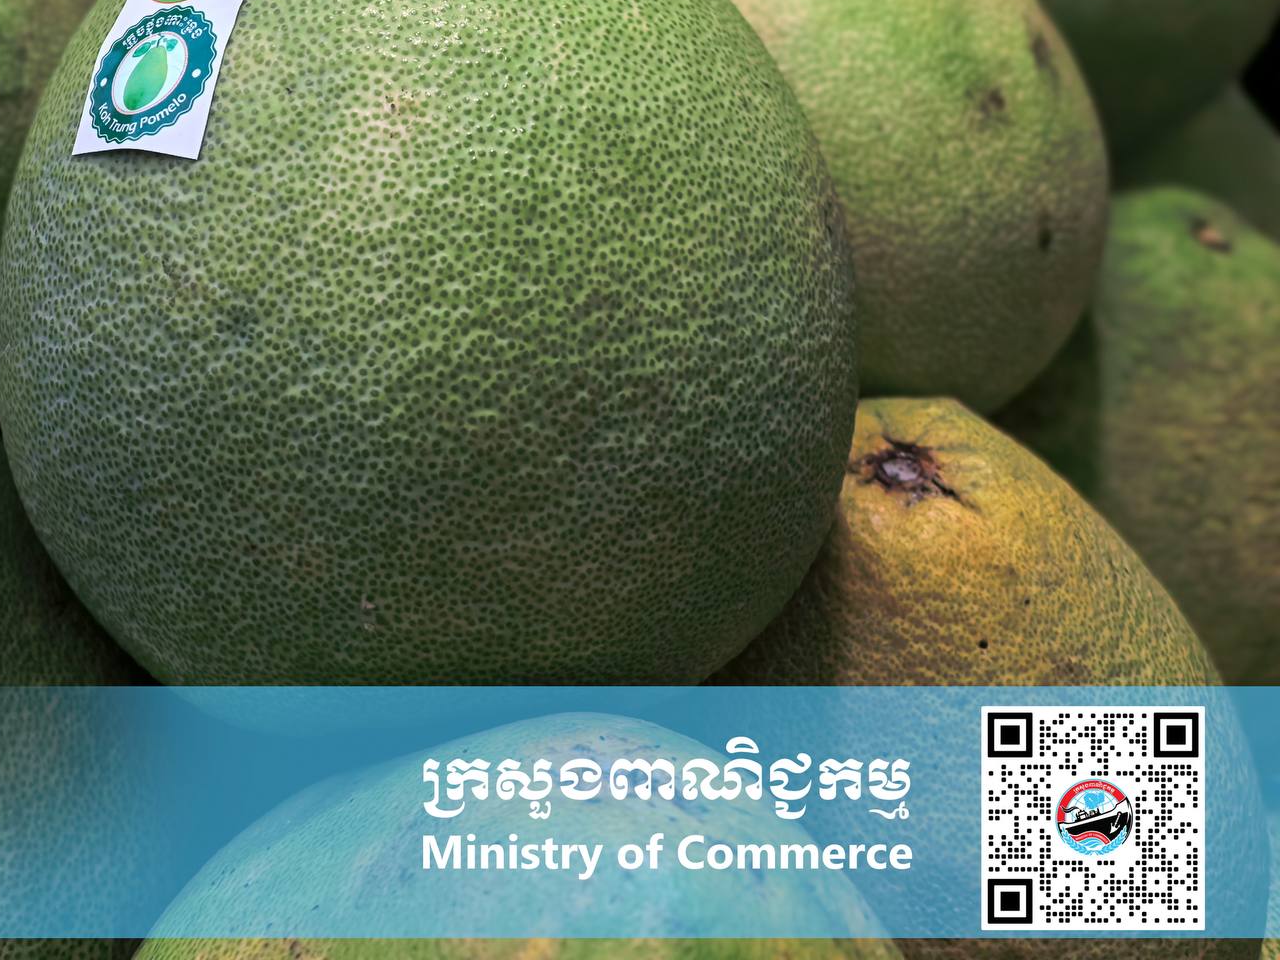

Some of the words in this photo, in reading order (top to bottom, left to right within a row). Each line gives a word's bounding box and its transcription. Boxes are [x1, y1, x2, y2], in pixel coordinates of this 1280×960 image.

[98, 102, 111, 125] Koh
[109, 117, 138, 135] Trung
[139, 93, 187, 129] Pomelo
